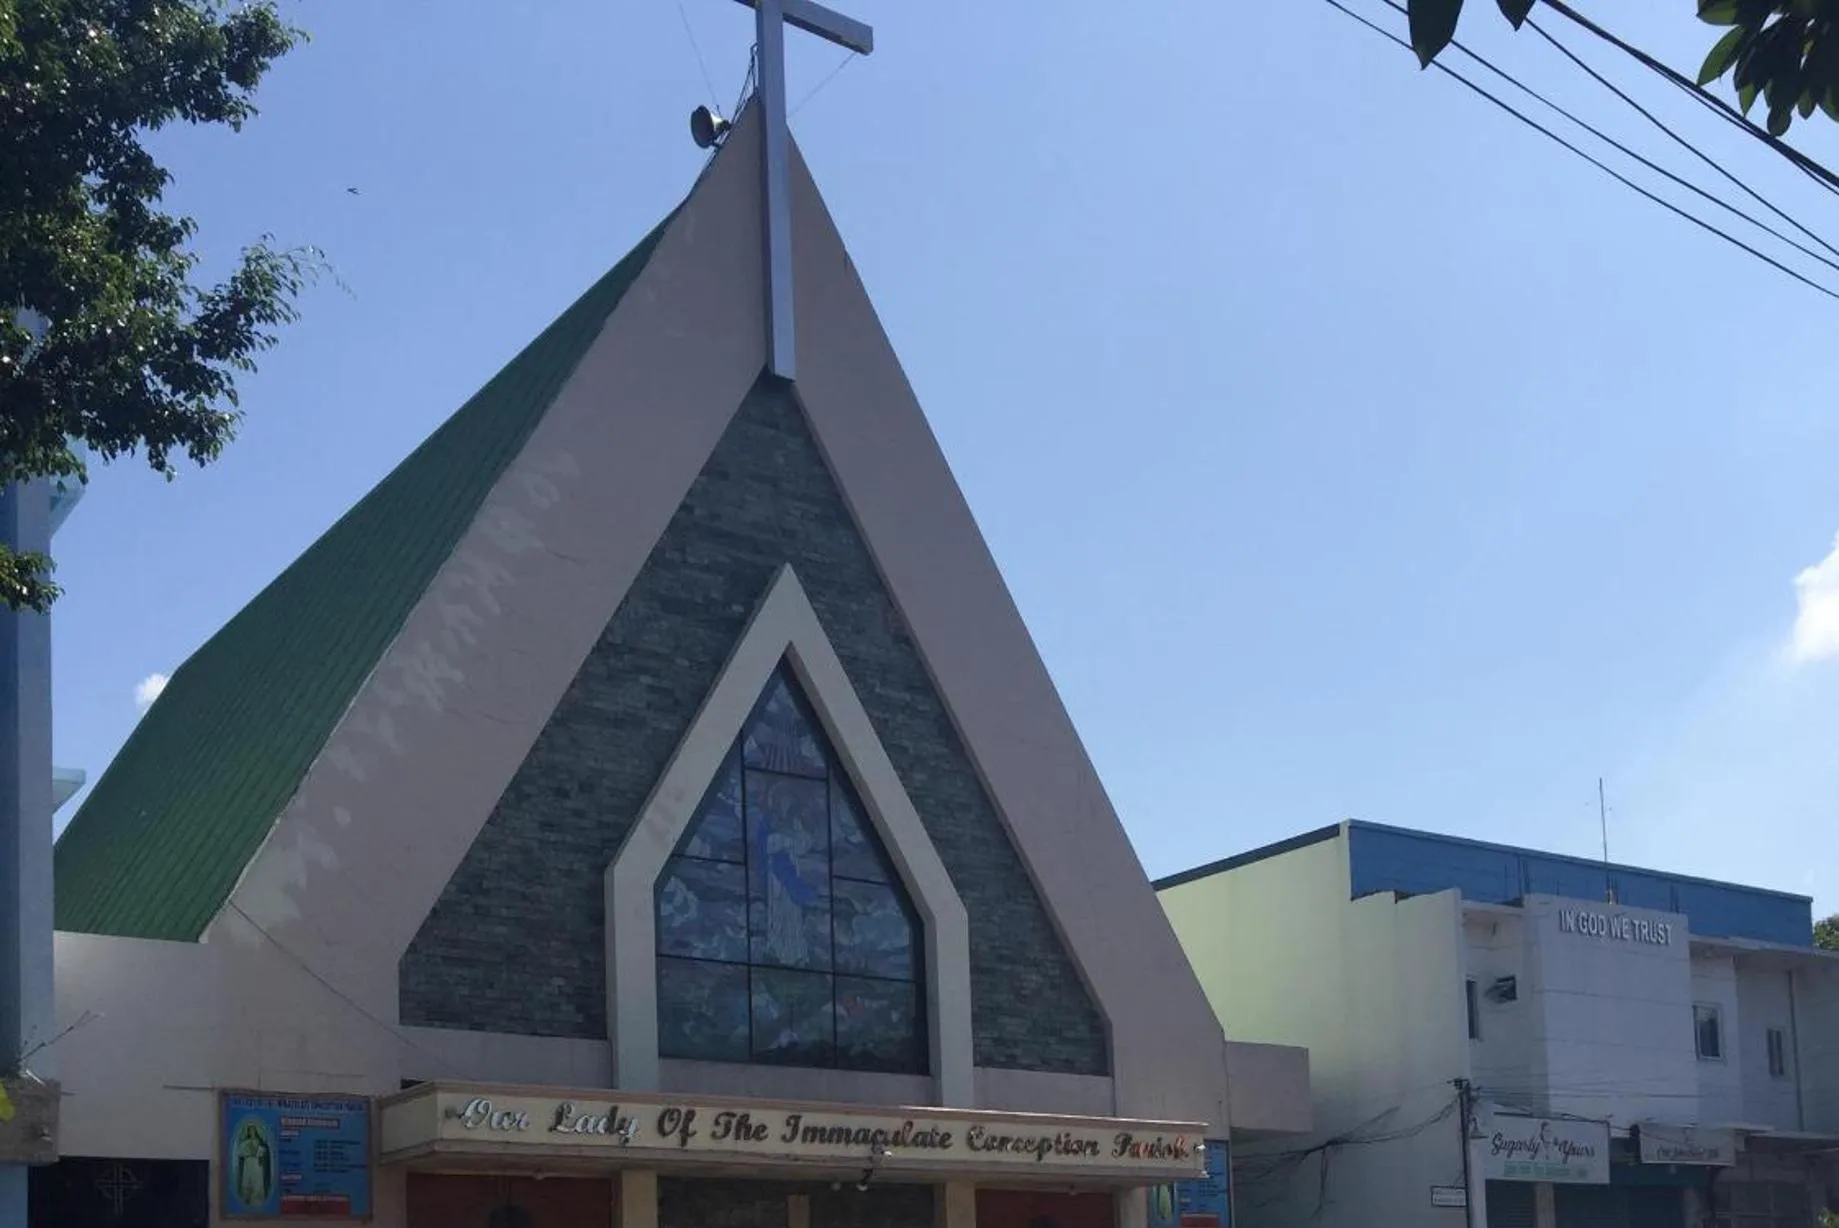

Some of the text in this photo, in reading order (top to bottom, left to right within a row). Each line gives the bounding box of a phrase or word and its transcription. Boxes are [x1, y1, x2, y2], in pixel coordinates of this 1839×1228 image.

[1560, 909, 1673, 946] IN GOD WE TRUST
[445, 1098, 530, 1131] Our
[548, 1101, 637, 1147] Lady
[656, 1106, 697, 1148] Of
[710, 1111, 768, 1142] The
[781, 1114, 953, 1151] Immaculate
[966, 1124, 1100, 1161] Conception
[1111, 1131, 1190, 1160] Parish
